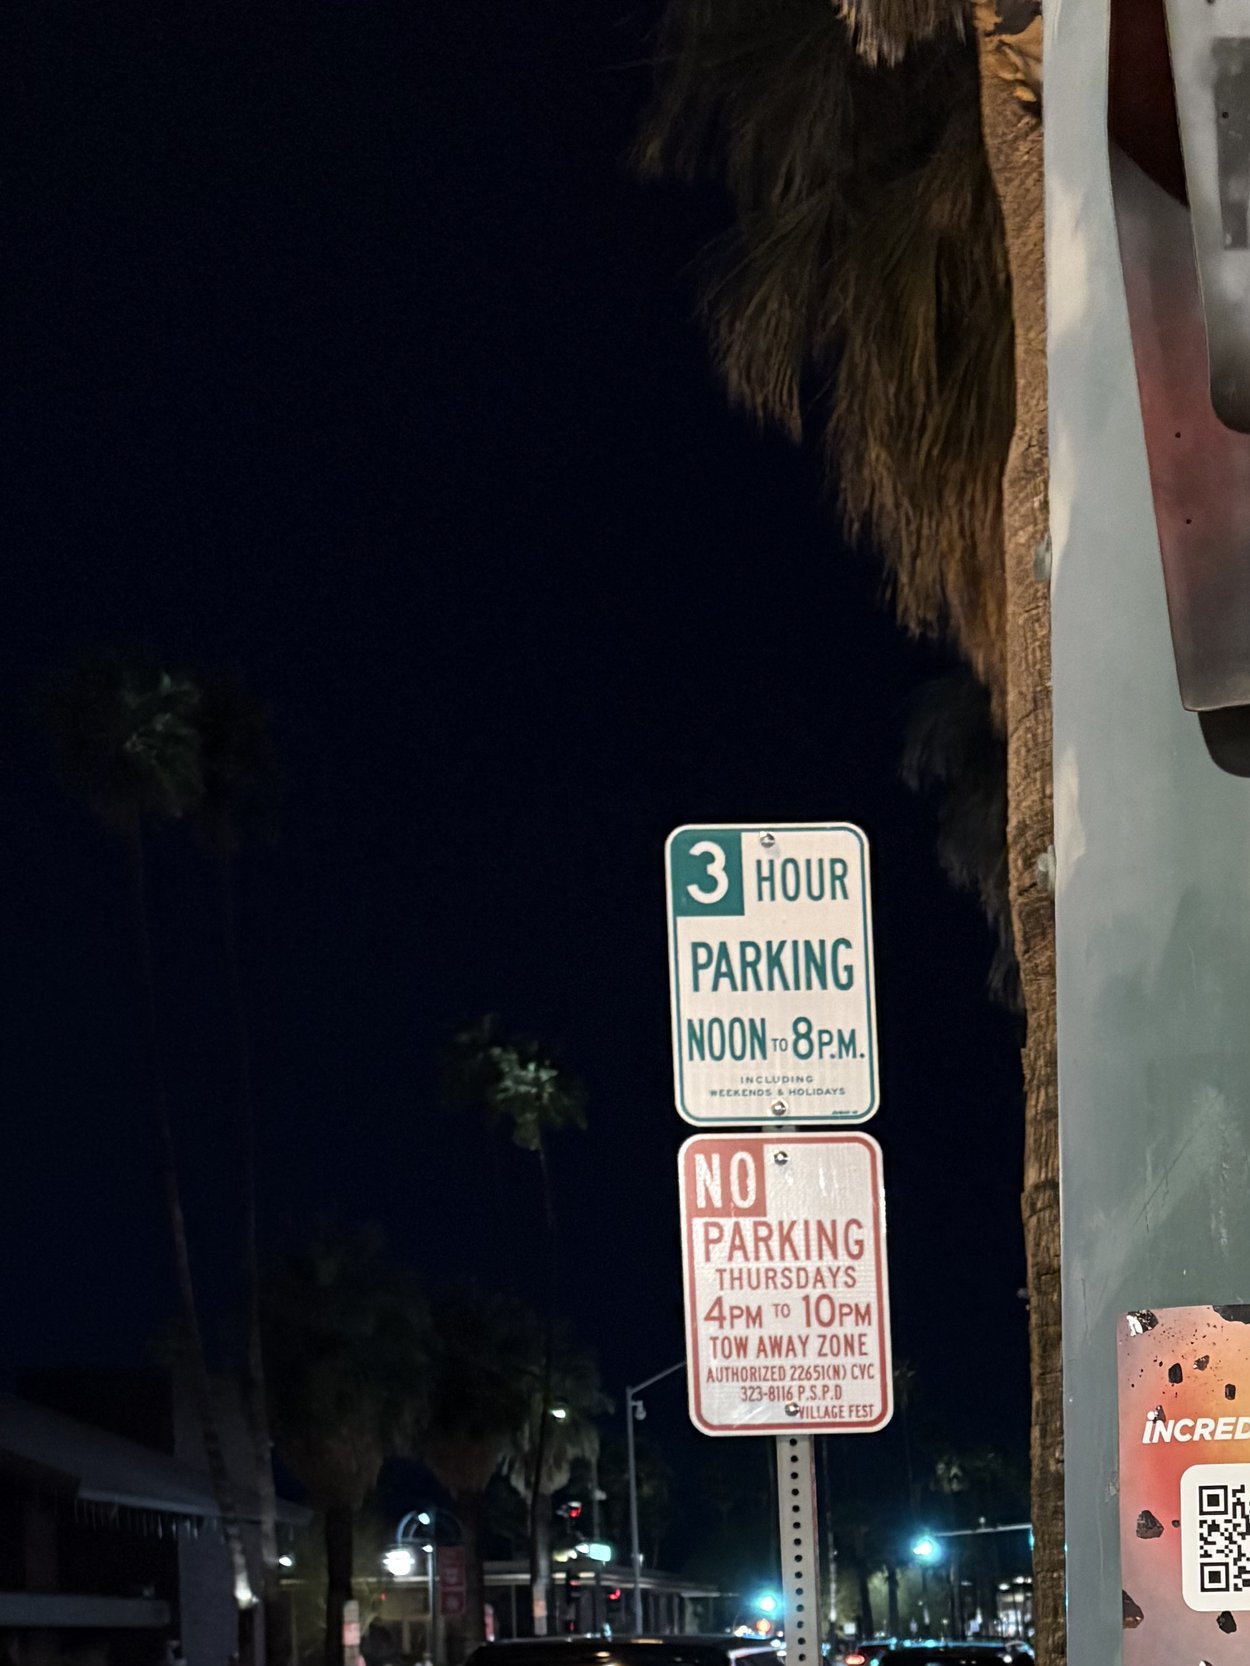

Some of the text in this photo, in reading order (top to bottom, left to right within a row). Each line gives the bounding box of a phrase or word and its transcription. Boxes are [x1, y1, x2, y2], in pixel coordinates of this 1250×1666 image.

[686, 840, 849, 904] 3 HOUR
[690, 938, 854, 993] PARKING
[687, 1017, 767, 1062] NOON
[771, 1038, 788, 1052] TO
[709, 1087, 846, 1097] WEEKENDS & HOLIDAYS
[740, 1075, 814, 1085] INCLUDING
[694, 1151, 757, 1209] NO
[703, 1218, 864, 1263] PARKING
[716, 1266, 857, 1291] THURSDAYS
[704, 1294, 872, 1329] 4PM TO 10PM
[709, 1333, 868, 1360] TOW AWAY ZONE
[706, 1363, 875, 1383] AUTHORIZED 22651(N) CVC
[740, 1385, 793, 1402] 323-8116
[799, 1404, 875, 1420] VILLAGE FEST
